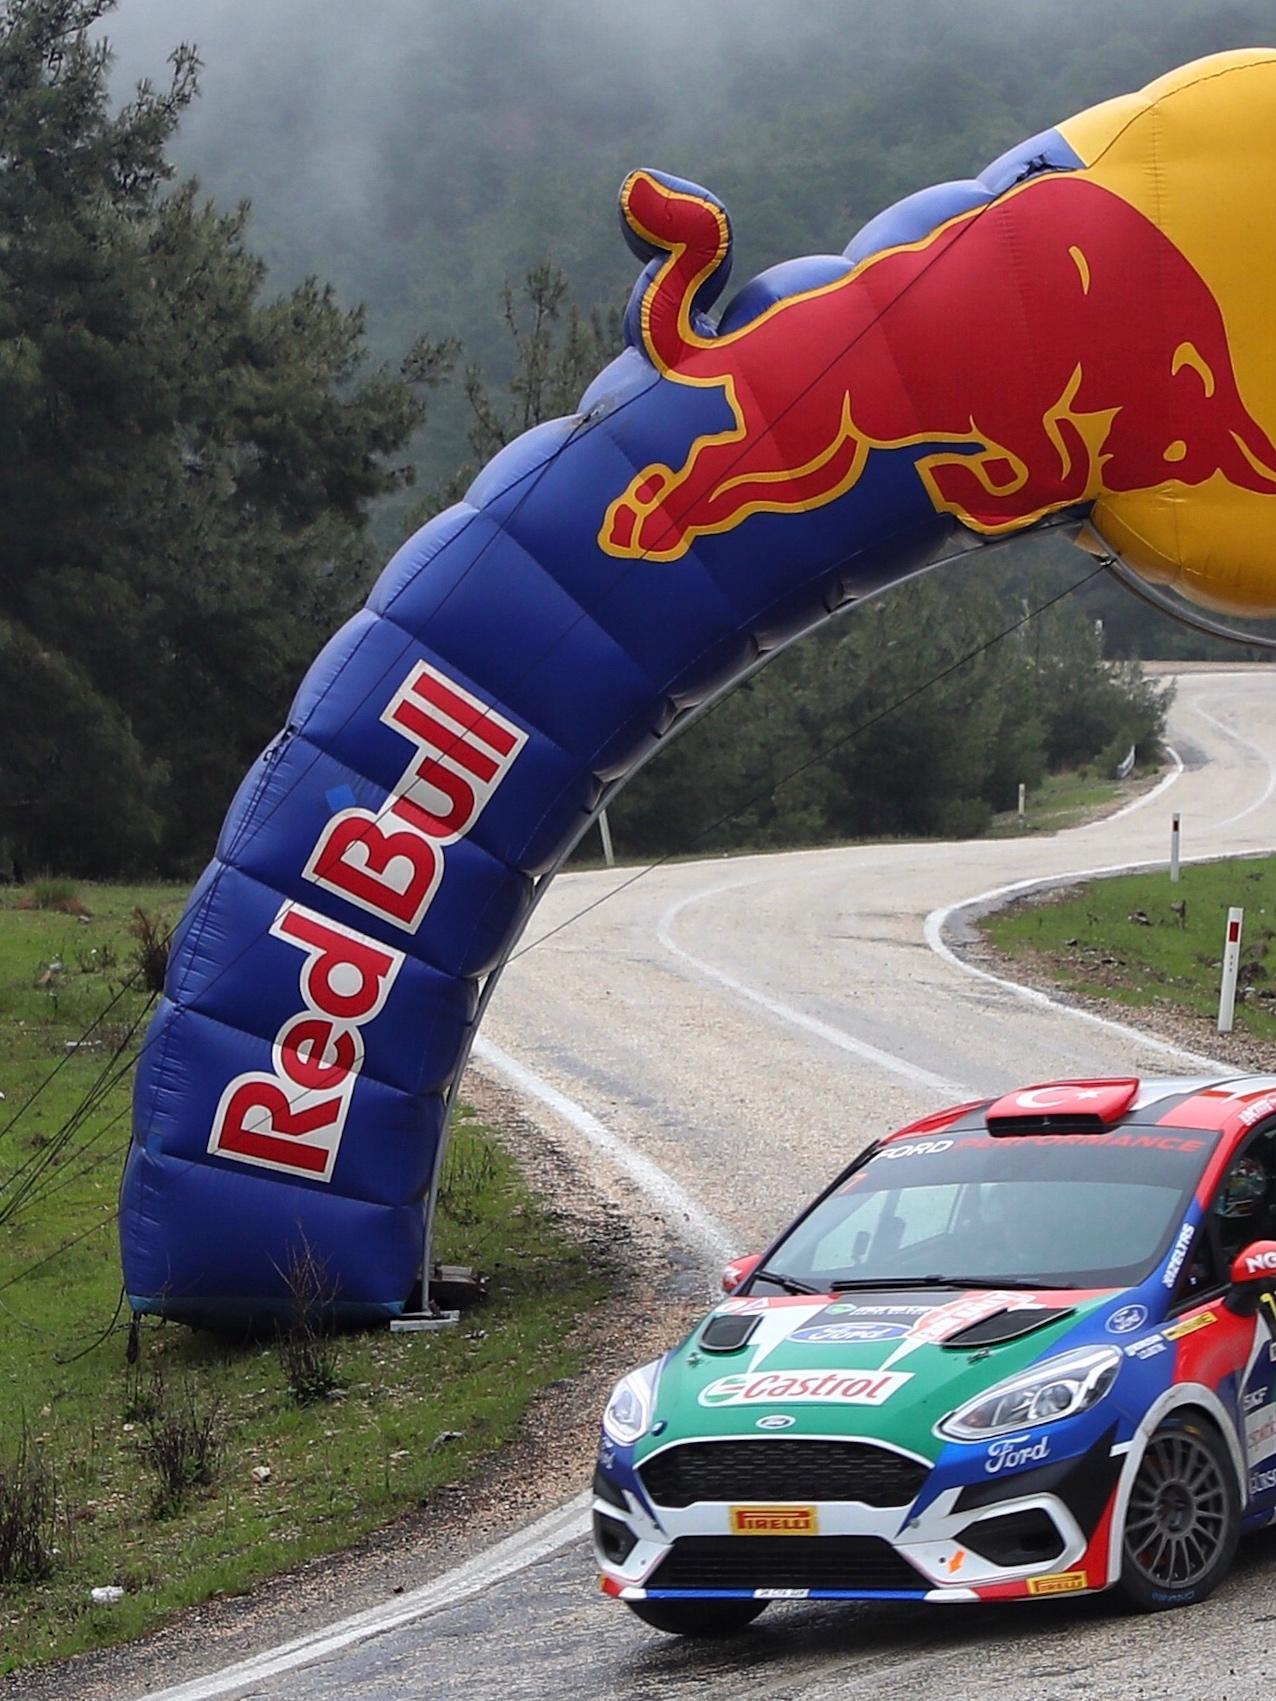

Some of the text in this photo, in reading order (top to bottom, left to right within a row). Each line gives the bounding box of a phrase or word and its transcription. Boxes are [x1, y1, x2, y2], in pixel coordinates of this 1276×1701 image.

[207, 659, 529, 1182] Red Bull
[870, 1133, 1206, 1163] FORD PERFORMANCE
[808, 1323, 891, 1340] Ford
[743, 1374, 894, 1400] Castrol
[985, 1434, 1051, 1474] Ford
[735, 1509, 812, 1530] PIRELLI
